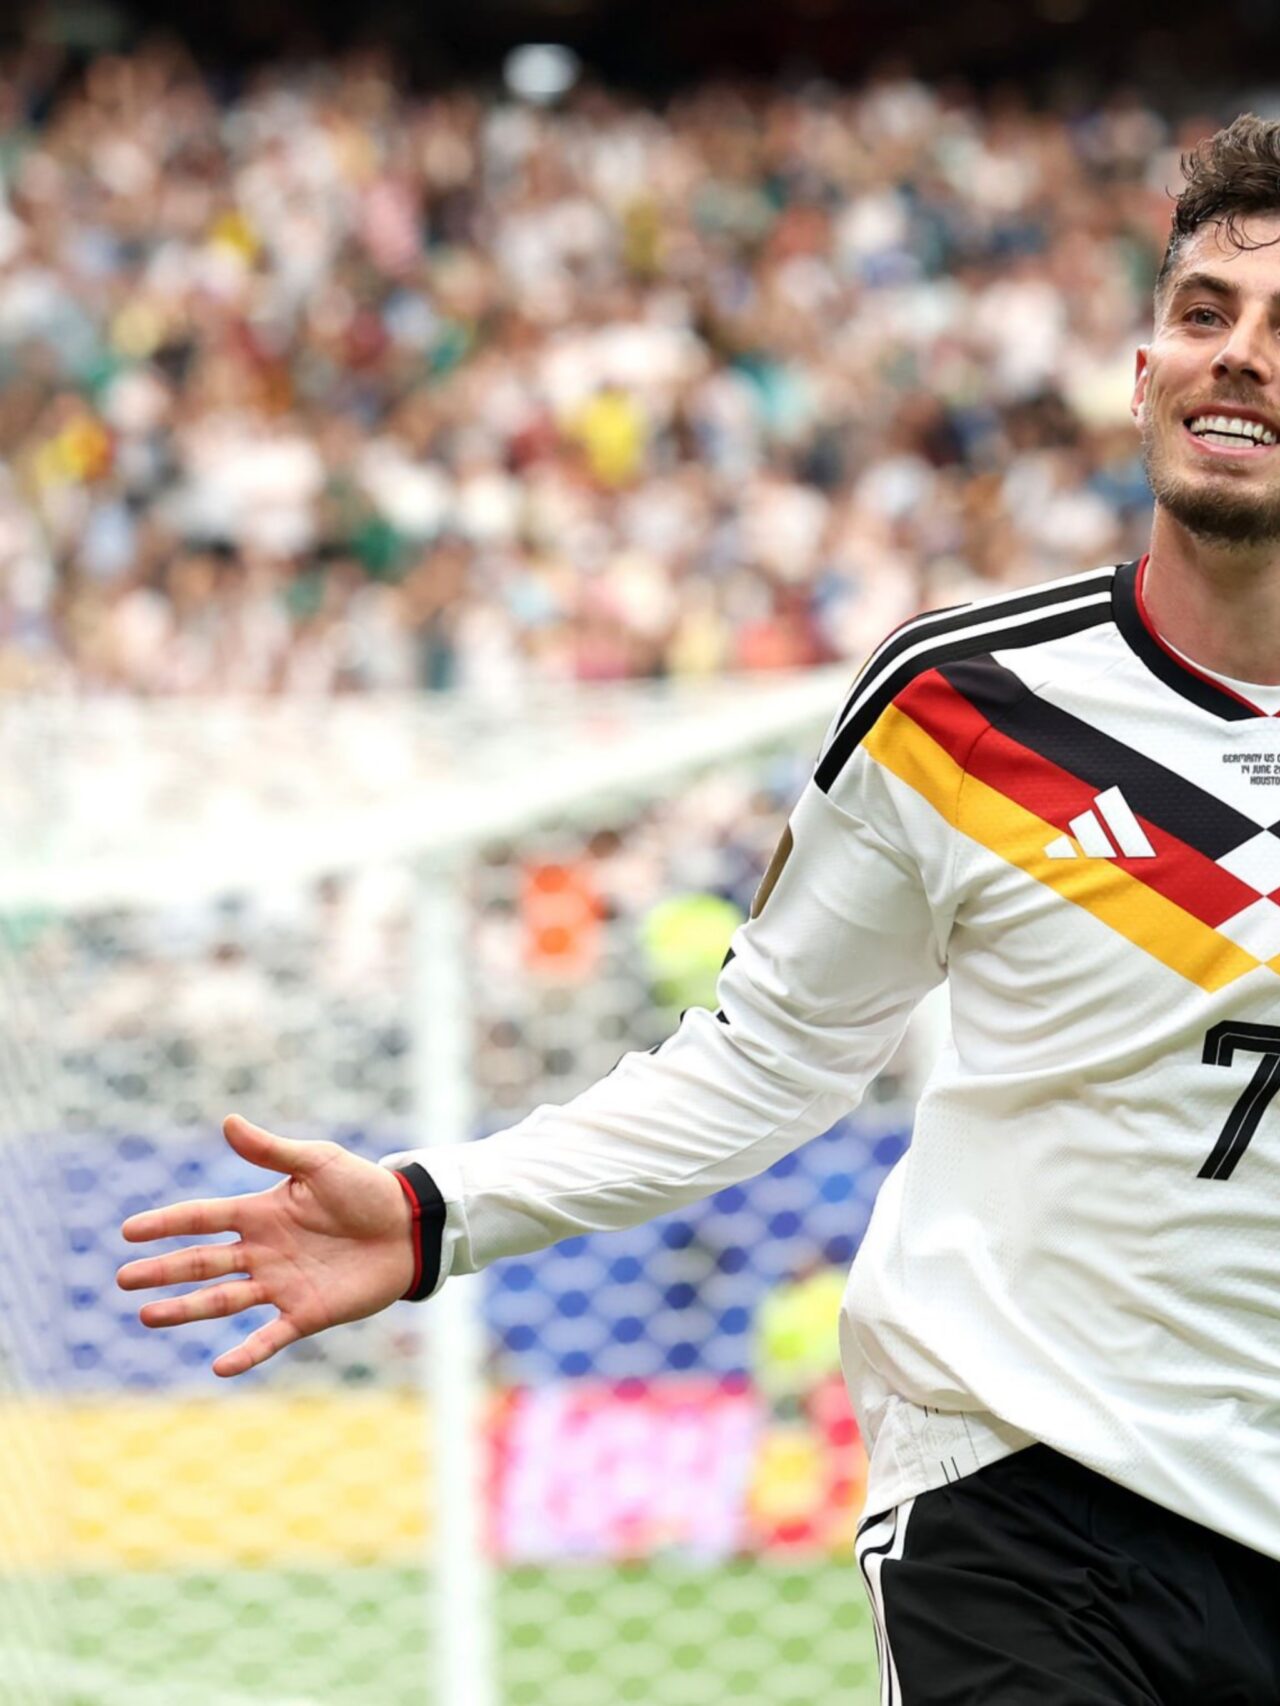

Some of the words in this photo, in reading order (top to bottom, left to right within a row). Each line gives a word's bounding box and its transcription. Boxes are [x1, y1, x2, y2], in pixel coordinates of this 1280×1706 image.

[1222, 753, 1262, 763] GERMANY
[1241, 765, 1250, 774] 14
[1252, 765, 1272, 774] JUNE
